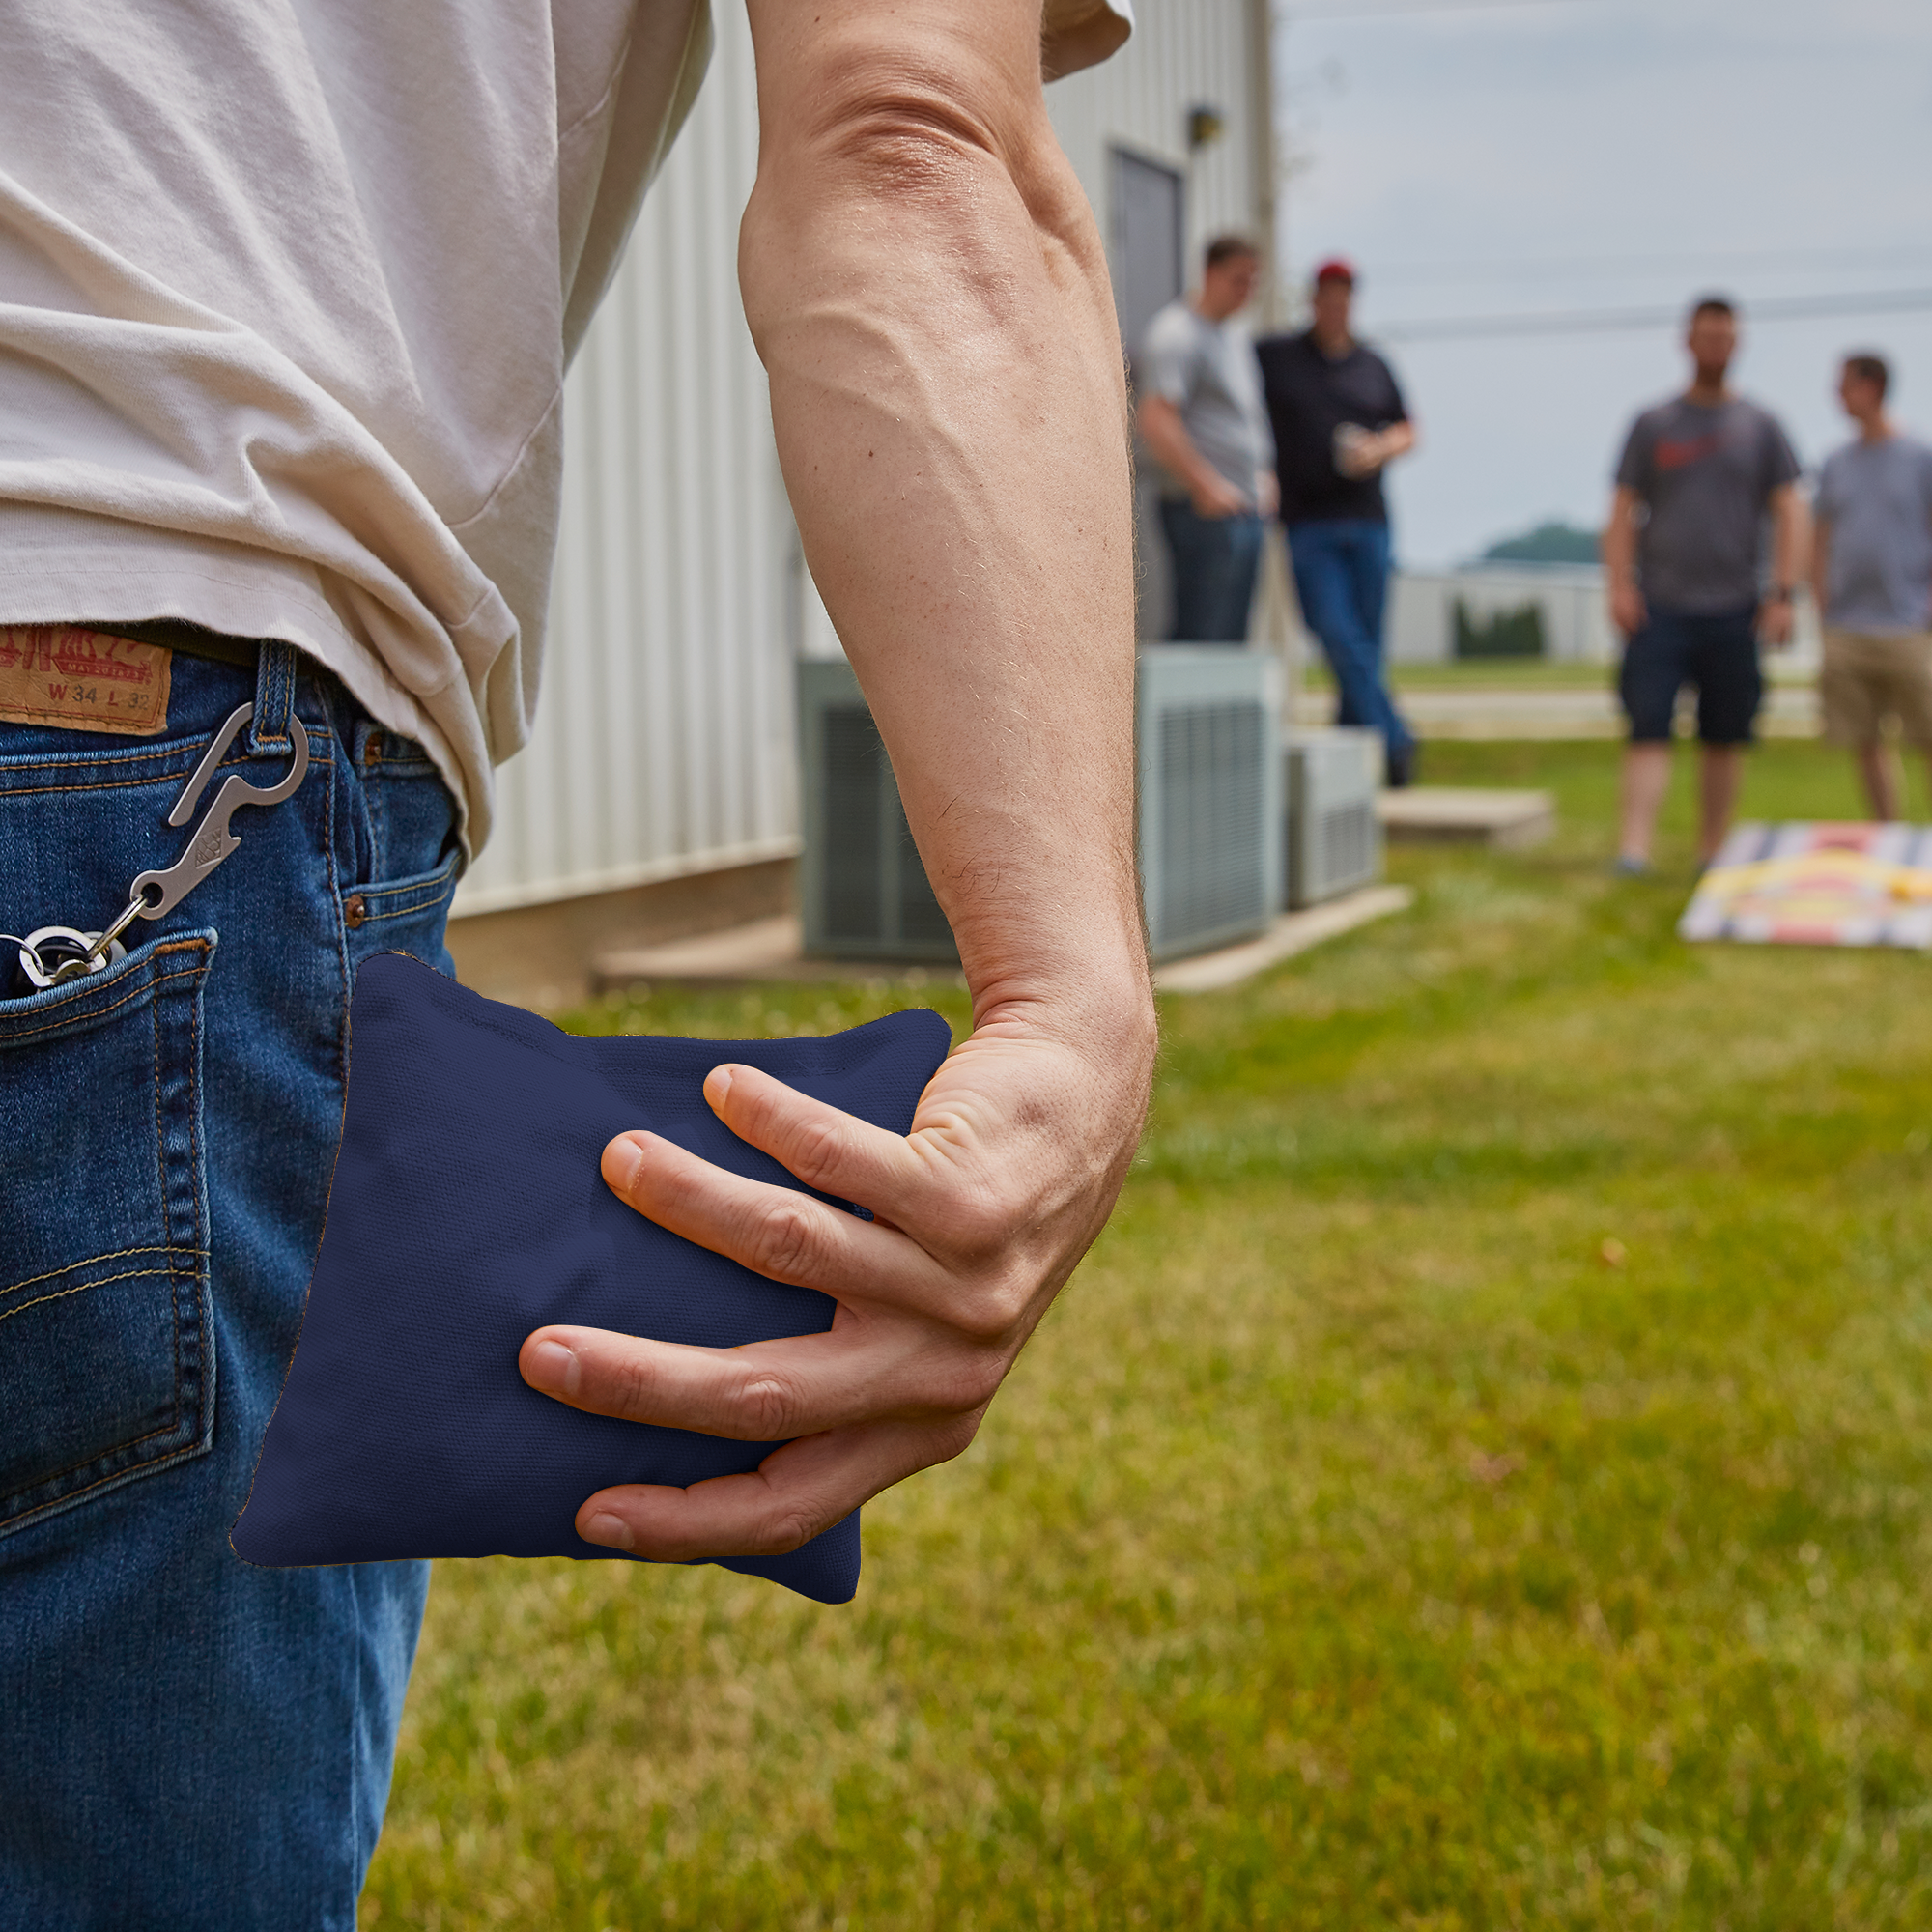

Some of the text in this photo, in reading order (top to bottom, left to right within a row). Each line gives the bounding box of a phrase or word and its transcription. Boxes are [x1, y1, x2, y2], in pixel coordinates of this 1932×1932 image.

[48, 683, 149, 710] W 34 L 32
